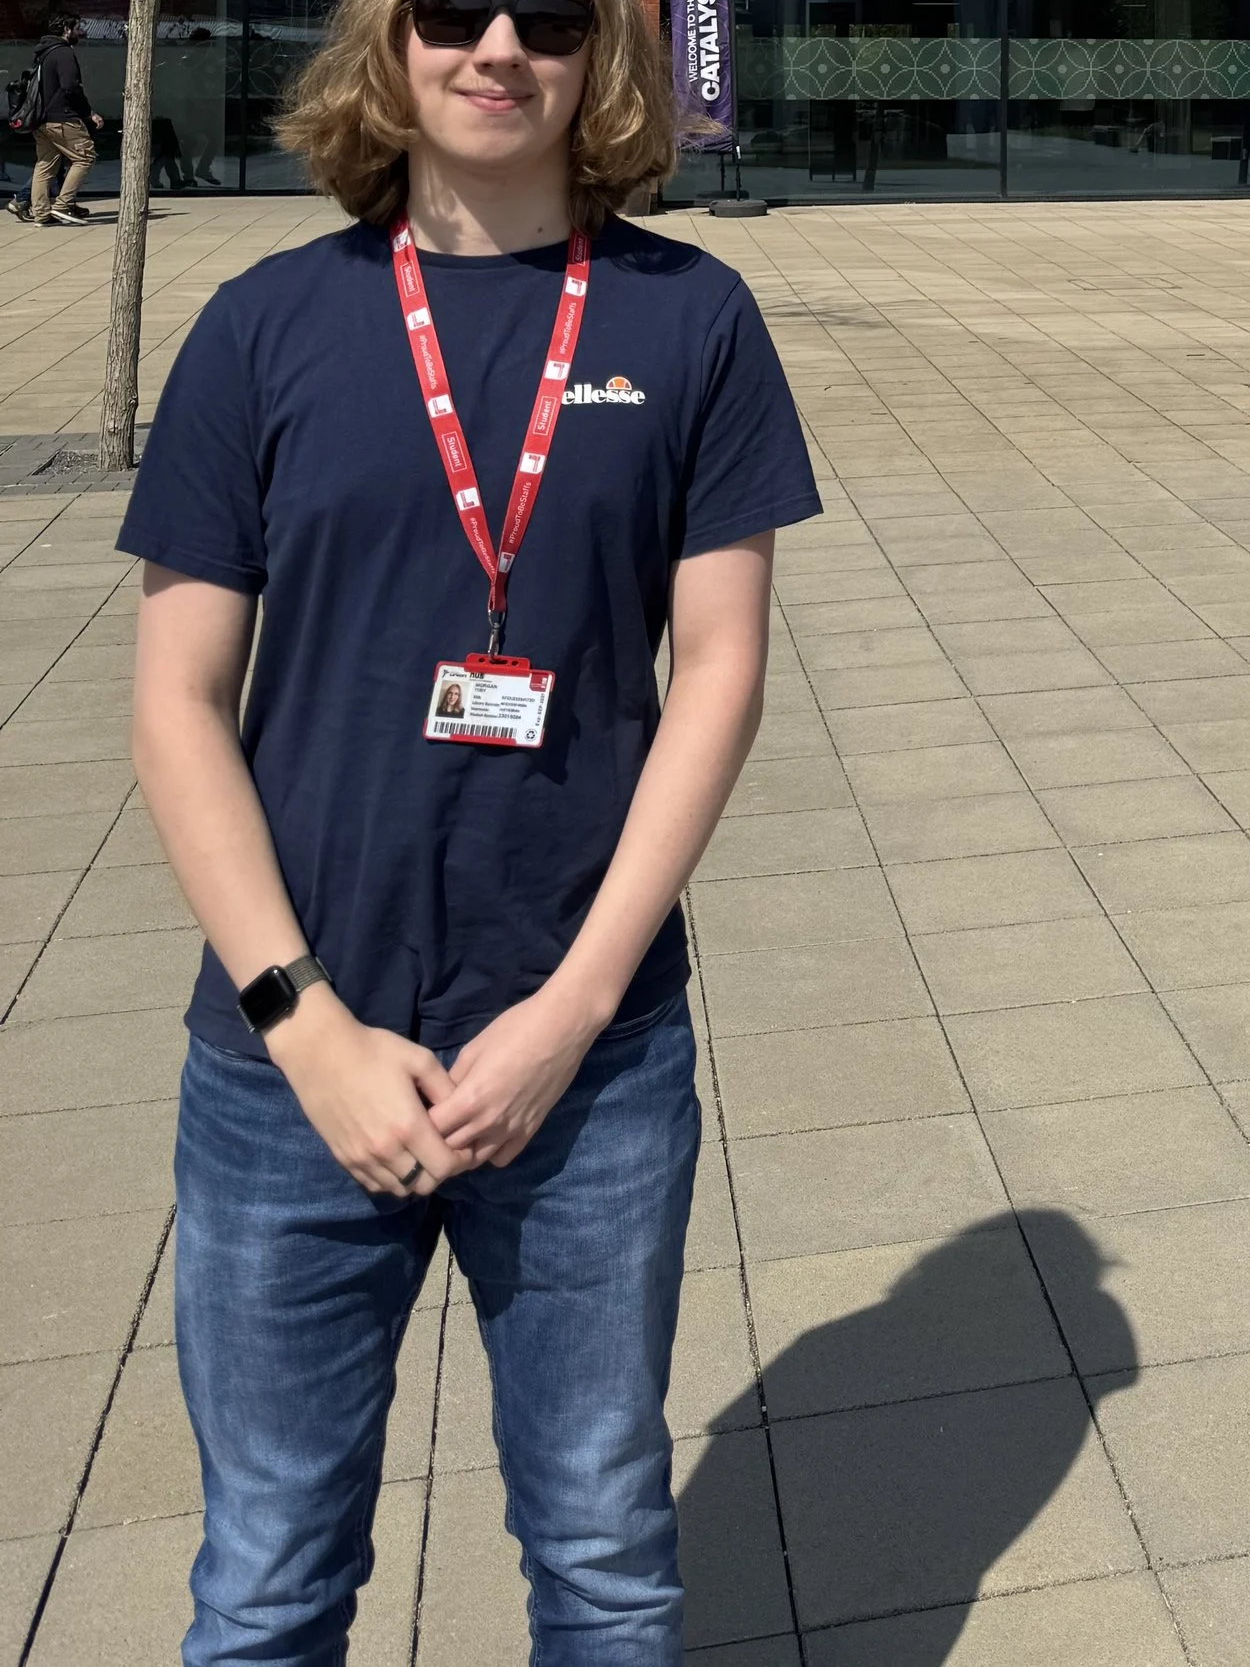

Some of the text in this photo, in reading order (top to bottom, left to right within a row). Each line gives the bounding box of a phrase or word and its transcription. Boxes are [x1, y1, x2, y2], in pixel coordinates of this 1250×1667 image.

[687, 14, 696, 30] TO
[687, 30, 698, 82] WELCOME
[561, 383, 646, 405] ellesse
[537, 400, 552, 432] Student
[447, 436, 463, 468] Student
